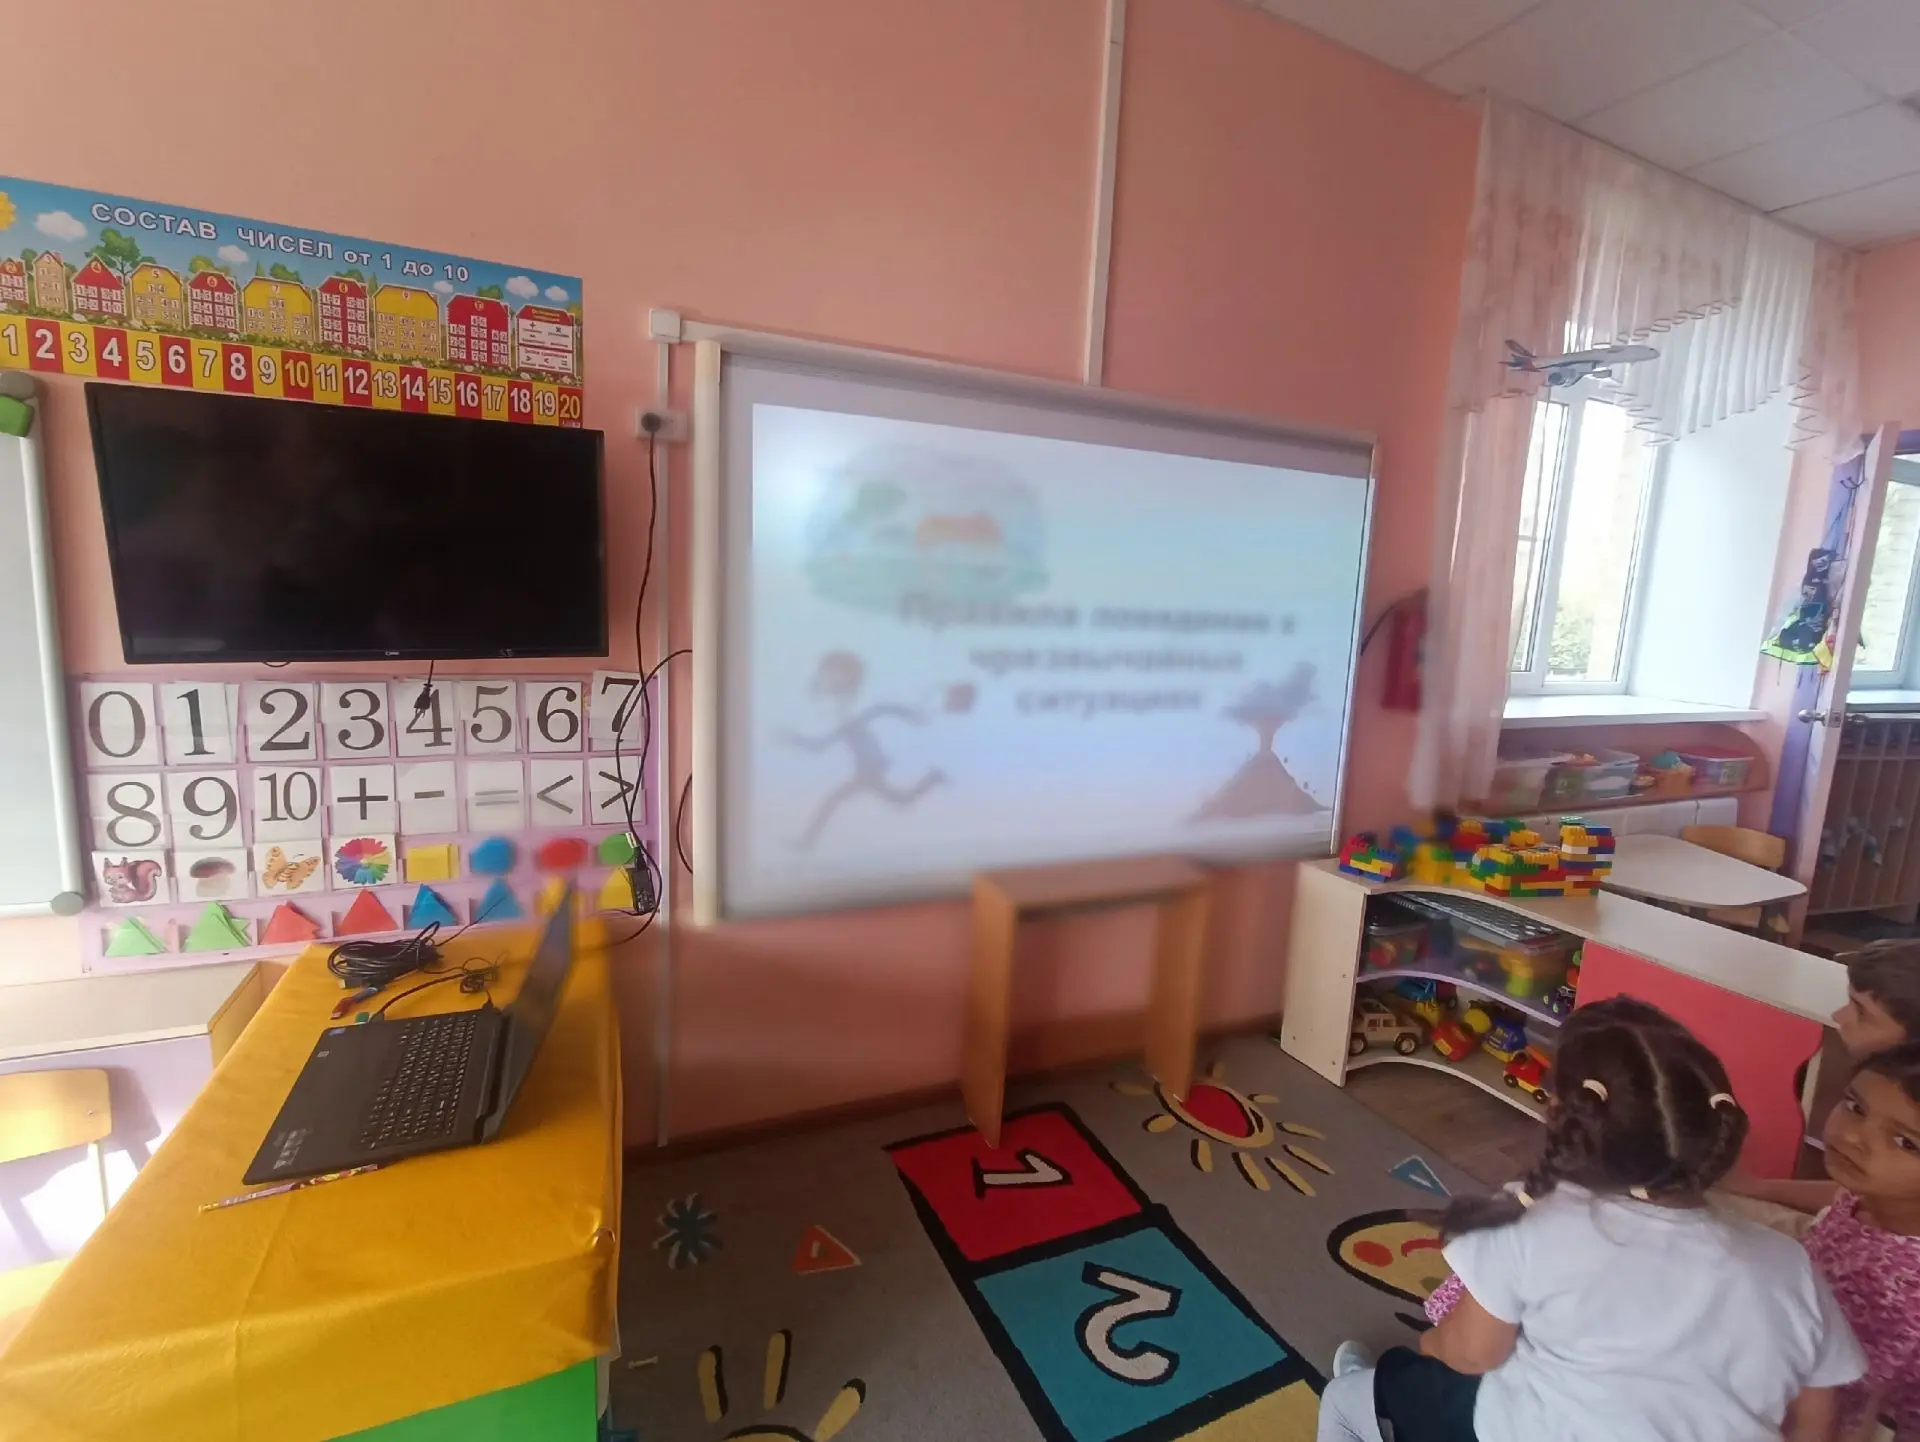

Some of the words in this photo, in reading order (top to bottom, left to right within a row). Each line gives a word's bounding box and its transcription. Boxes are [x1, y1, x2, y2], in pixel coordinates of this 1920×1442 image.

[91, 203, 217, 240] СОСТАВ
[237, 227, 333, 260] ЧИСЕЛ
[344, 251, 372, 265] от
[381, 253, 392, 269] 1
[402, 260, 433, 277] до
[443, 264, 469, 282] 10
[2, 323, 18, 356] 1
[35, 328, 56, 359] 2
[68, 331, 89, 363] 3
[102, 337, 122, 367] 4
[136, 340, 156, 371] 5
[168, 344, 187, 374] 6
[198, 348, 217, 377] 7
[230, 352, 247, 381] 8
[257, 355, 277, 385] 9
[284, 358, 309, 388] 10
[315, 363, 338, 392] 11
[344, 365, 369, 395] 12
[372, 369, 397, 398] 13
[401, 373, 426, 402] 14
[428, 376, 452, 405] 15
[456, 380, 479, 407] 16
[483, 383, 505, 411] 17
[509, 387, 531, 413] 18
[534, 389, 557, 417] 19
[559, 393, 581, 419] 20
[88, 689, 146, 759] 0
[177, 688, 216, 757] 1
[258, 688, 312, 752] 2
[337, 688, 385, 750] 3
[405, 684, 453, 748] 4
[470, 686, 513, 743] 5
[536, 687, 579, 744] 6
[600, 676, 641, 734] 7
[106, 781, 162, 847] 8
[182, 776, 238, 841] 9
[260, 771, 317, 823] 10
[972, 1147, 1074, 1199] 1
